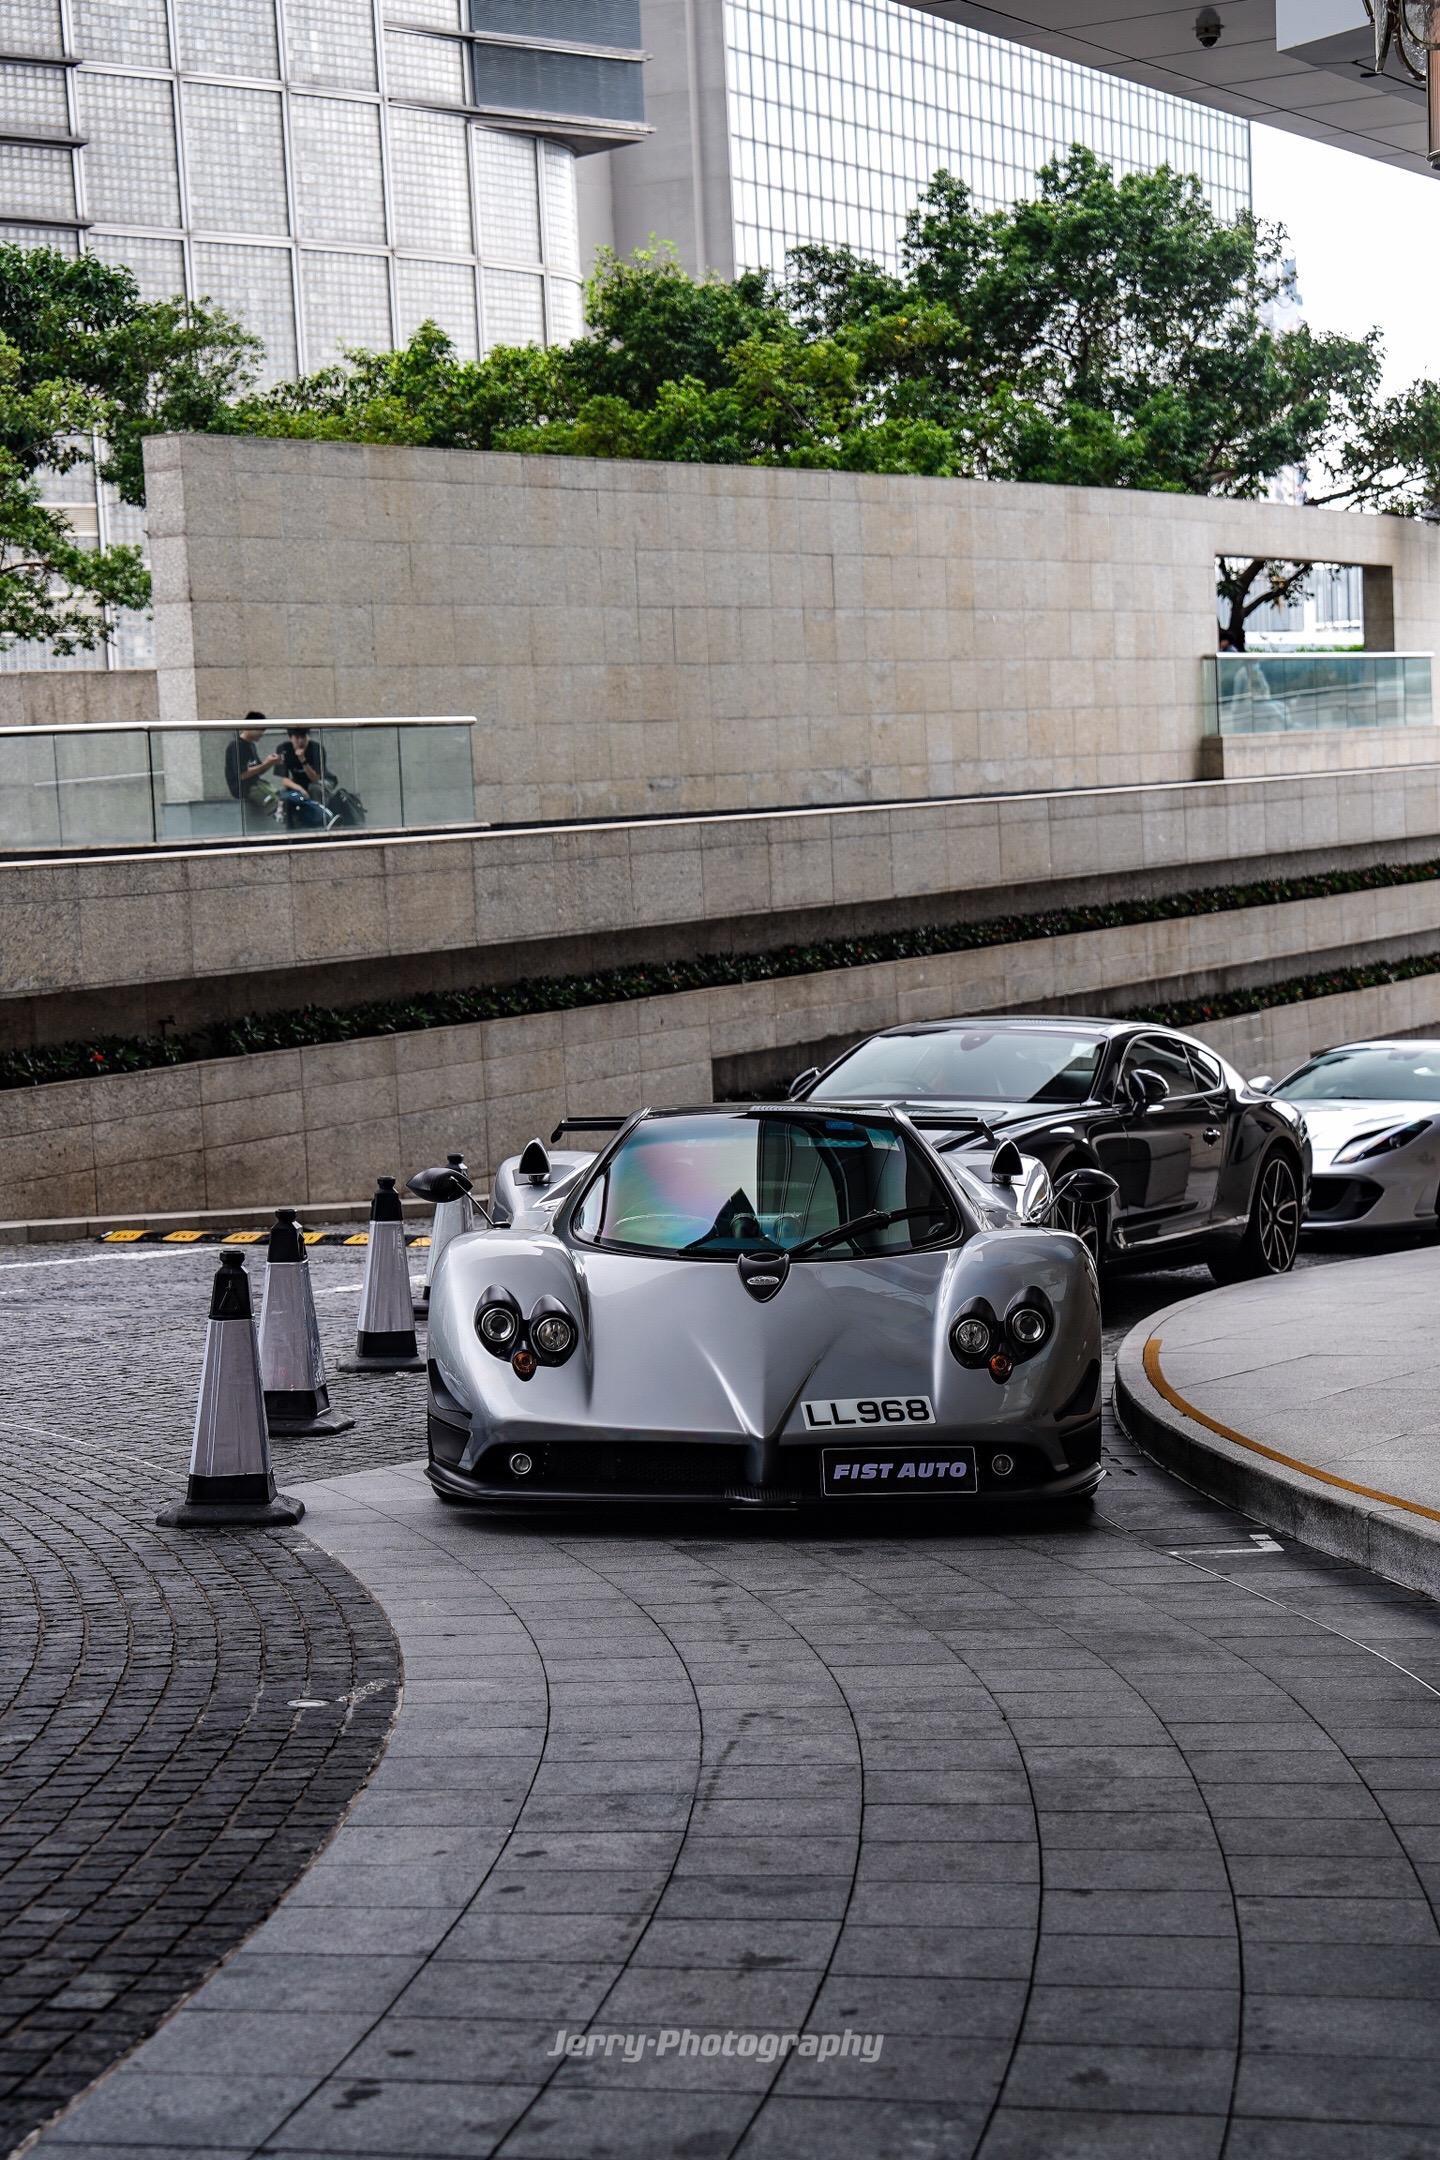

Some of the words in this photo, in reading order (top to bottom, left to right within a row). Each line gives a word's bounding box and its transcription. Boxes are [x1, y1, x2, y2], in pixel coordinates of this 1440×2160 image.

[805, 1399, 930, 1426] LL968
[833, 1463, 894, 1480] FIST
[897, 1462, 967, 1478] AUTO
